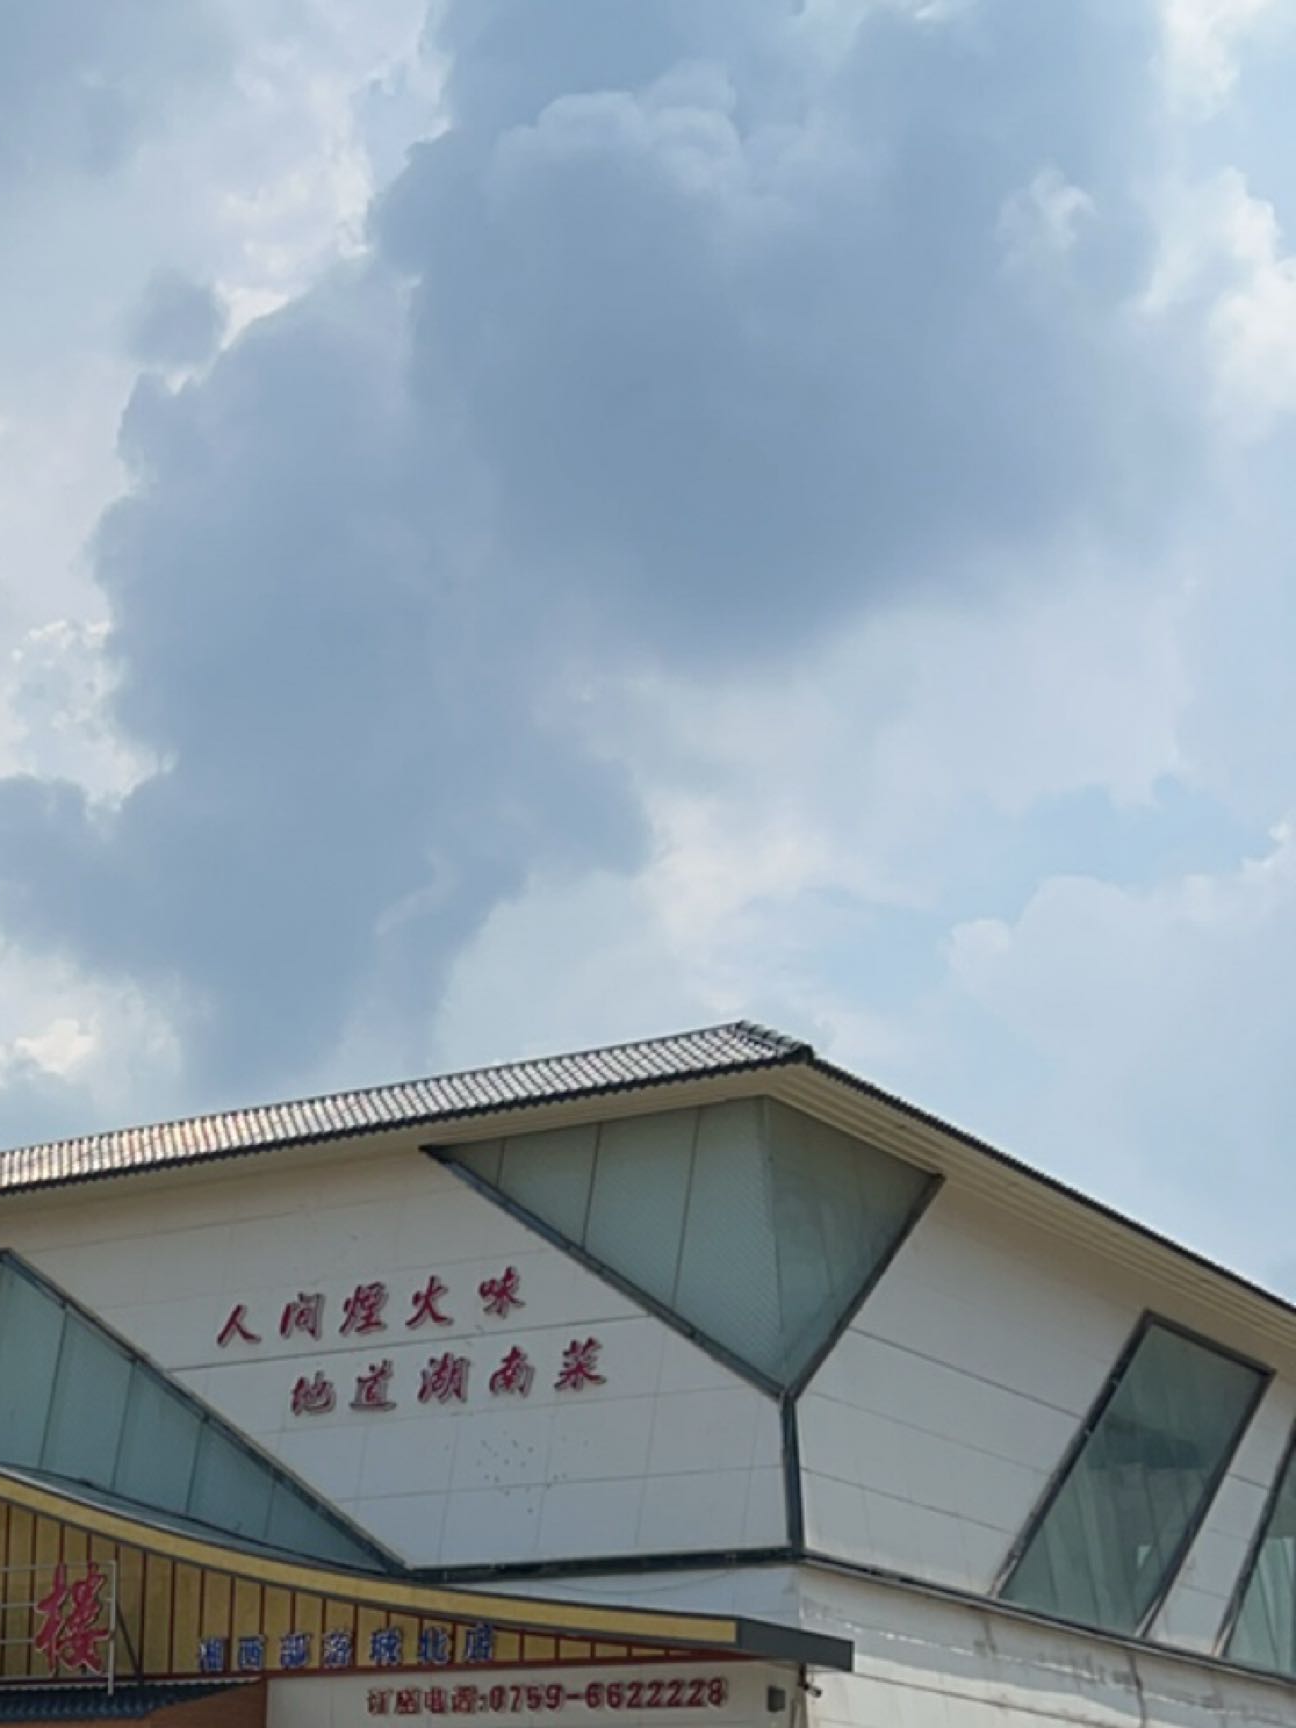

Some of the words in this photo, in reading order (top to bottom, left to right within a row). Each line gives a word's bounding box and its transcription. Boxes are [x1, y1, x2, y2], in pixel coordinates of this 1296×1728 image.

[290, 1337, 608, 1416] 地道湖南菜
